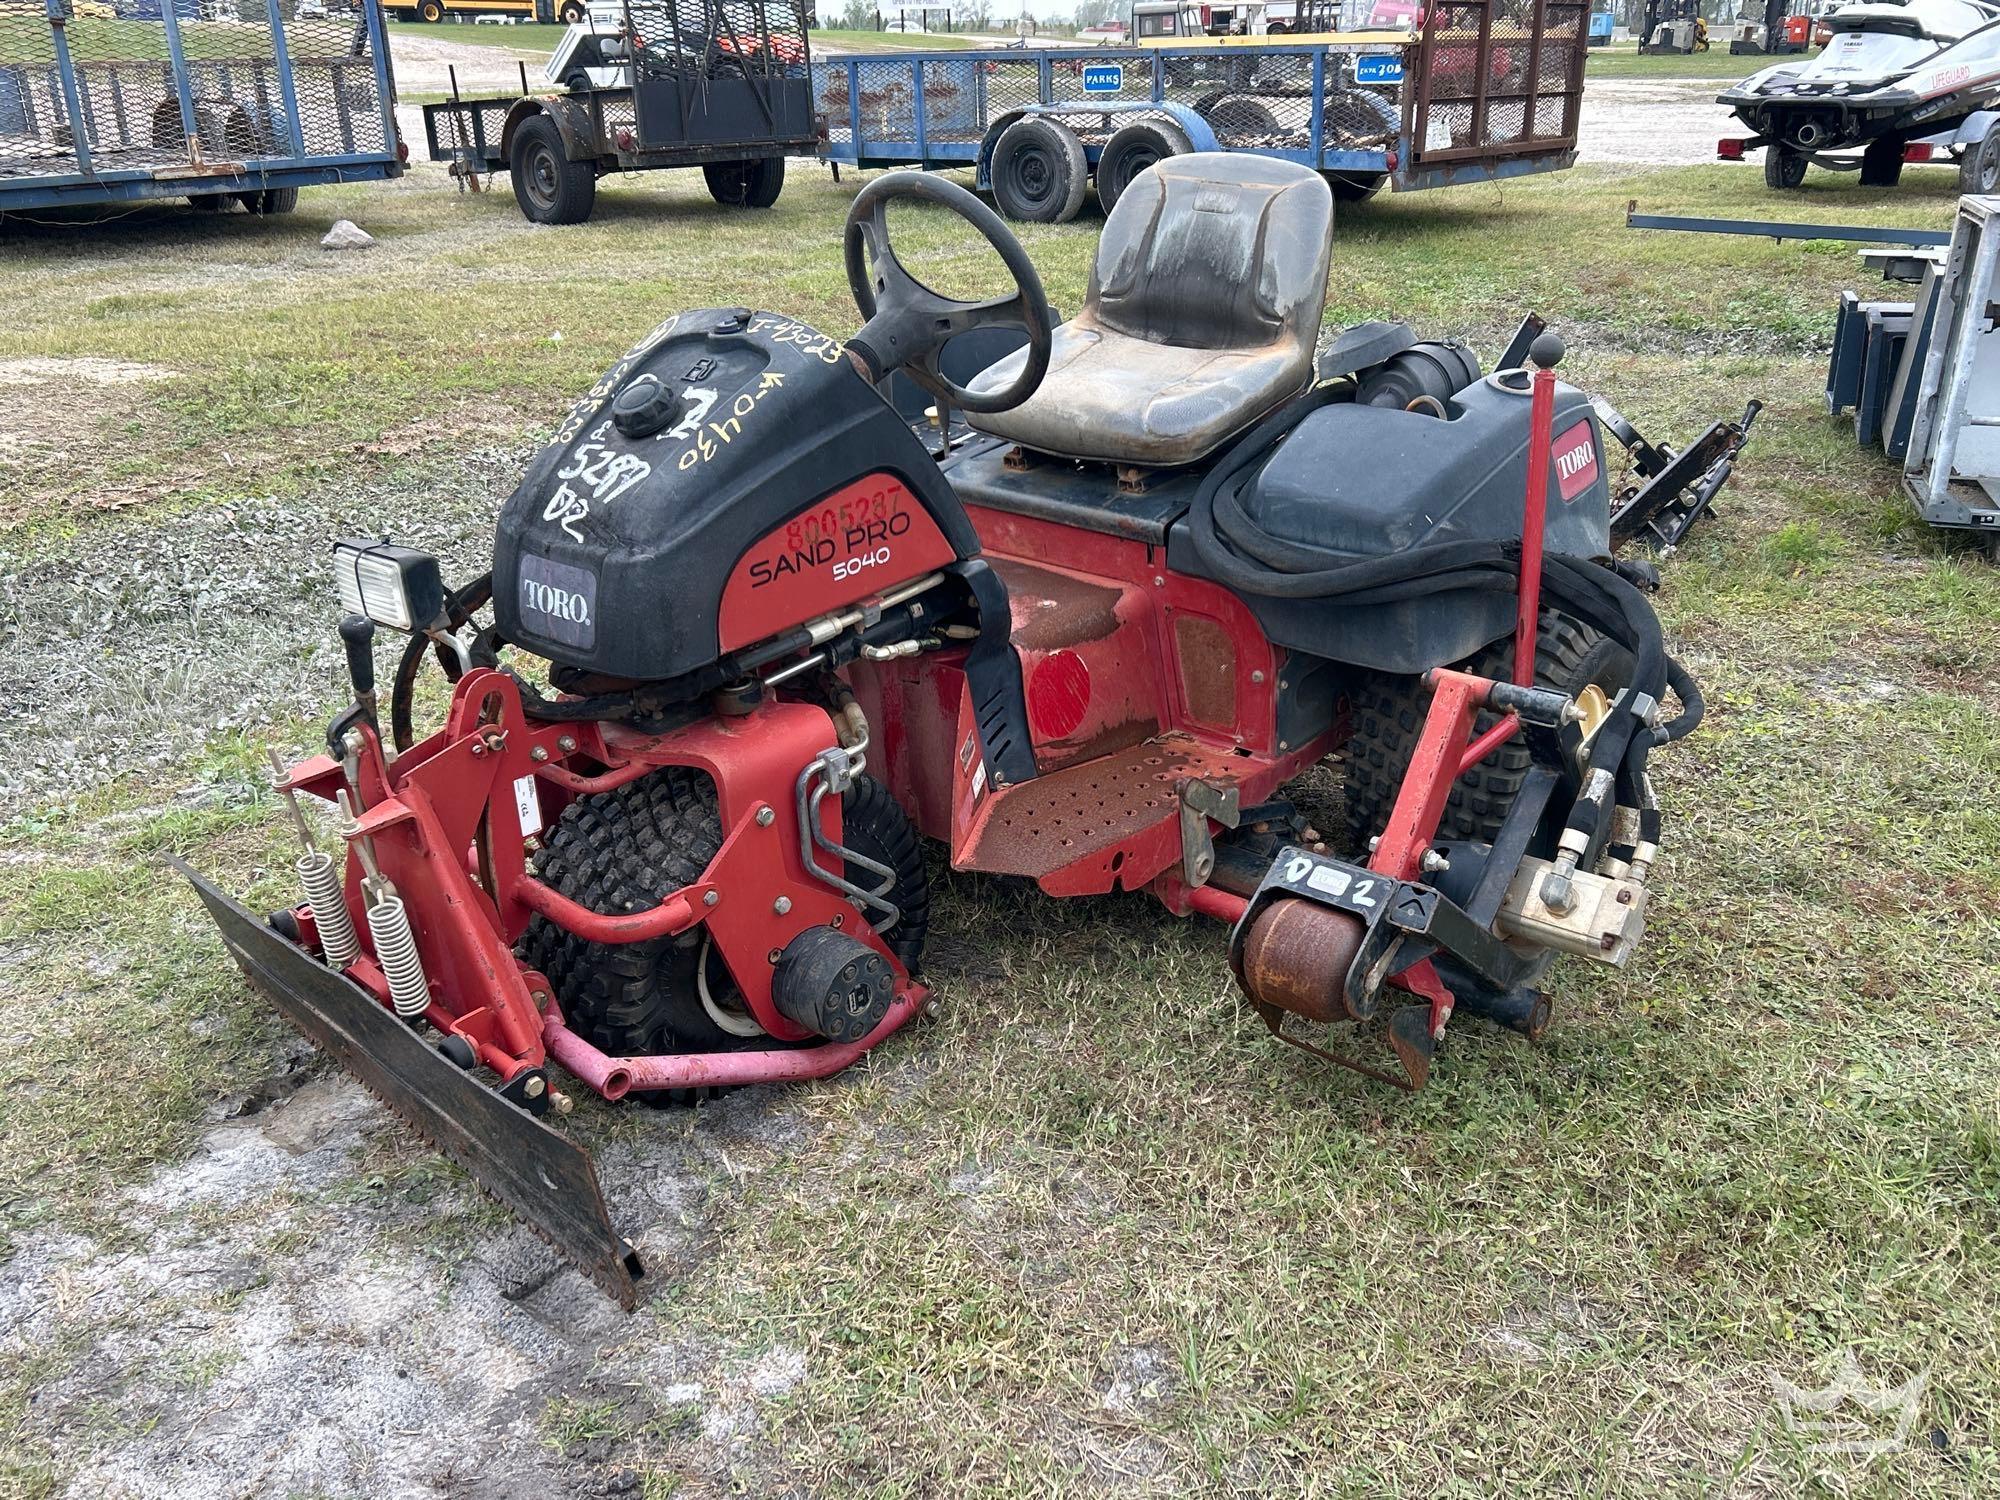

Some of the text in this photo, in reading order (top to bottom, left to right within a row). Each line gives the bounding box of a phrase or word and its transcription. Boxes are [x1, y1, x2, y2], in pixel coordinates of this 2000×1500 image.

[1086, 75, 1119, 85] PARKS
[1931, 66, 1970, 88] LIFEGUARD
[1557, 441, 1592, 480] TORO
[750, 511, 911, 589] SAND PRO
[832, 547, 890, 582] 5040
[524, 579, 588, 624] TORO
[1352, 880, 1377, 907] 2
